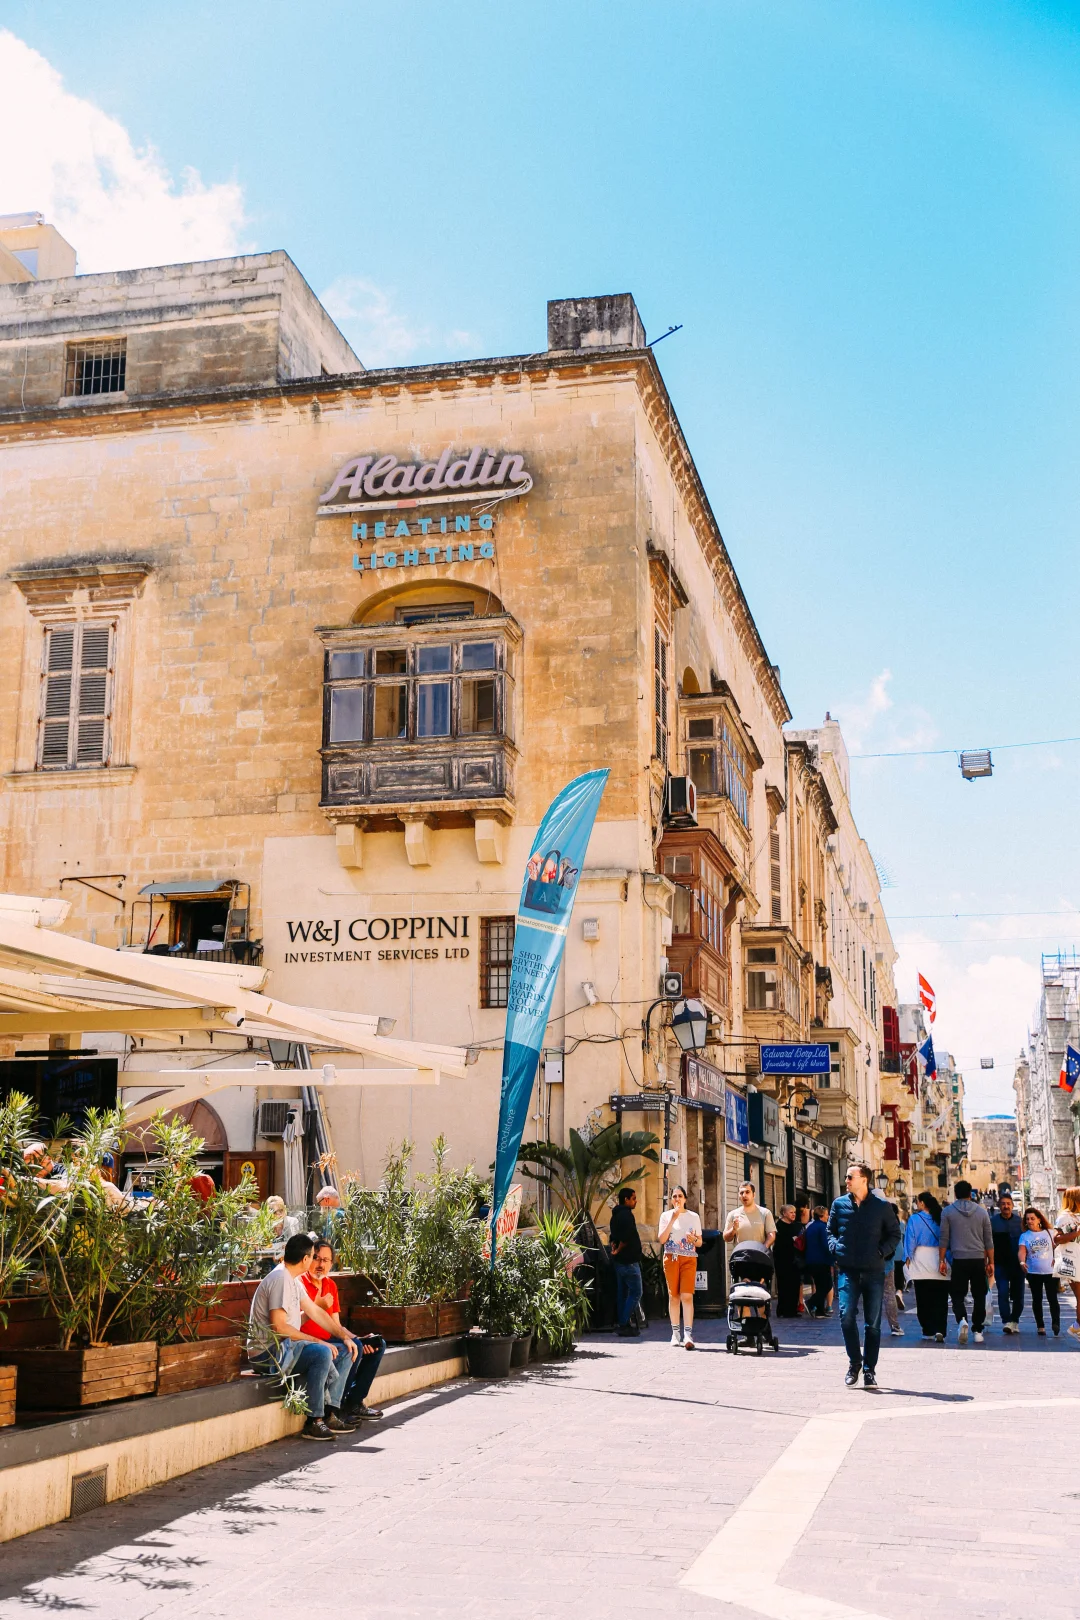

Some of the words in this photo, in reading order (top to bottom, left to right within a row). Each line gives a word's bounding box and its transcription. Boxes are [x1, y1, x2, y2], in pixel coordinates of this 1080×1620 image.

[318, 446, 532, 504] Aladdin
[352, 514, 493, 540] HEATING
[352, 542, 494, 570] LIGHTING
[286, 919, 341, 946] W&J
[348, 916, 470, 941] COPPINI
[285, 951, 371, 963] INVESTMENT
[378, 948, 439, 960] SERVICES
[445, 948, 470, 959] LTD
[519, 950, 542, 961] SHOP
[511, 965, 524, 974] OU
[513, 956, 556, 974] ERYTHING
[511, 980, 536, 992] EARN
[510, 988, 546, 1002] WARDS
[508, 1004, 544, 1018] SERVE!
[763, 1048, 795, 1058] Edward
[794, 1048, 813, 1060] Borg
[498, 1108, 516, 1154] Foodstore
